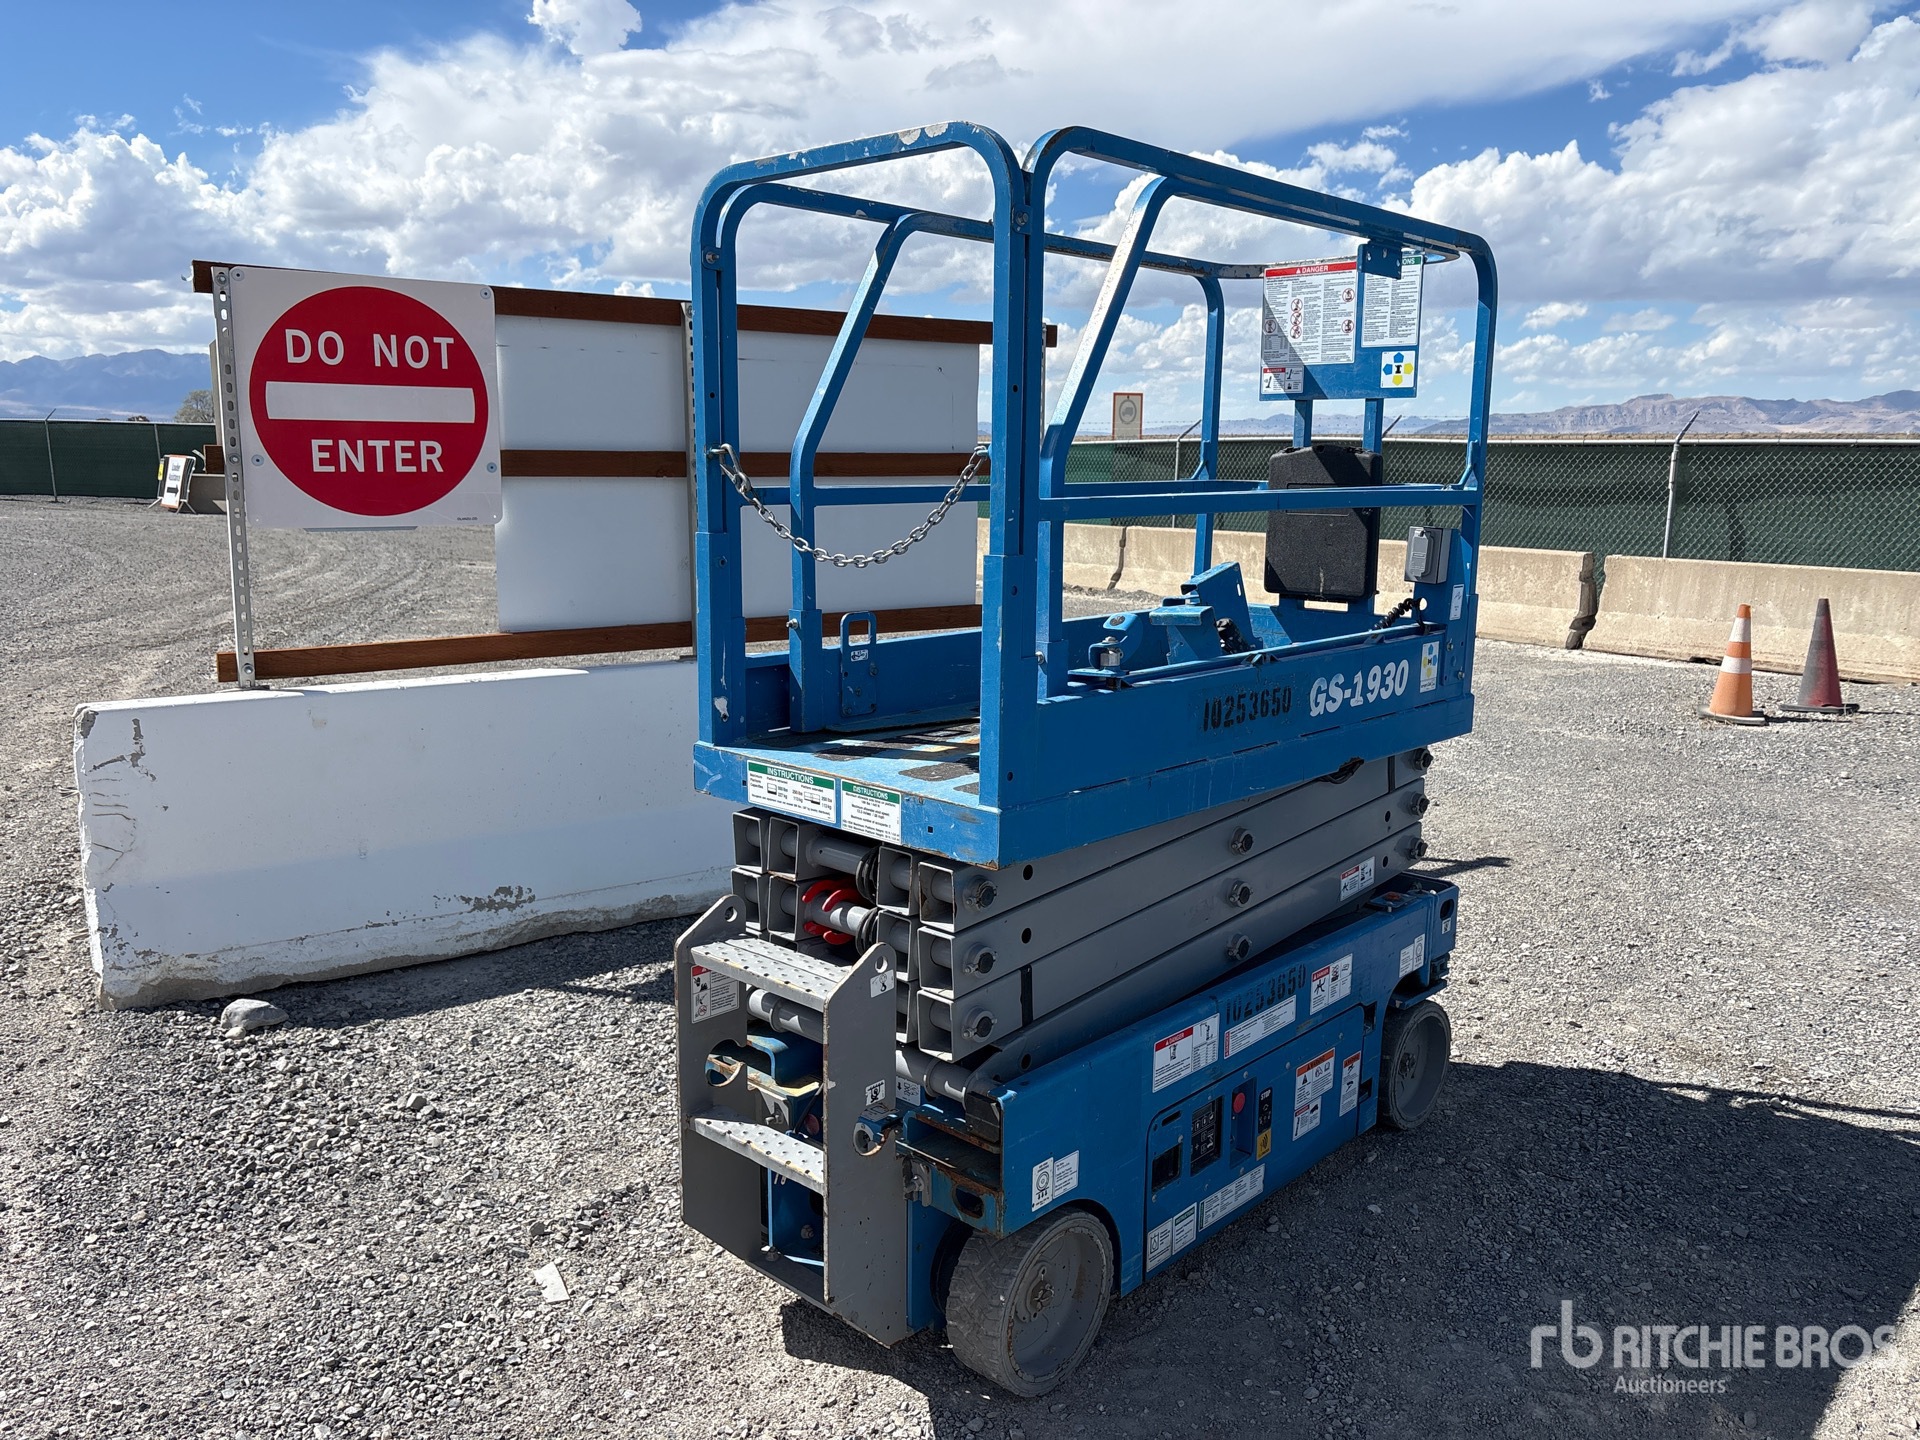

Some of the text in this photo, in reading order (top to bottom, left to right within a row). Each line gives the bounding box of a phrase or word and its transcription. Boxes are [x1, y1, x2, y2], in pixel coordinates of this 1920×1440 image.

[1302, 265, 1329, 273] DANGER
[284, 328, 455, 370] DO NOT
[310, 439, 444, 473] ENTER
[1309, 659, 1409, 717] GS-1930
[1203, 686, 1292, 731] 10253650
[766, 766, 814, 785] INSTRUCTIONS
[1226, 963, 1307, 1025] 10253650
[1260, 1089, 1271, 1101] STOP
